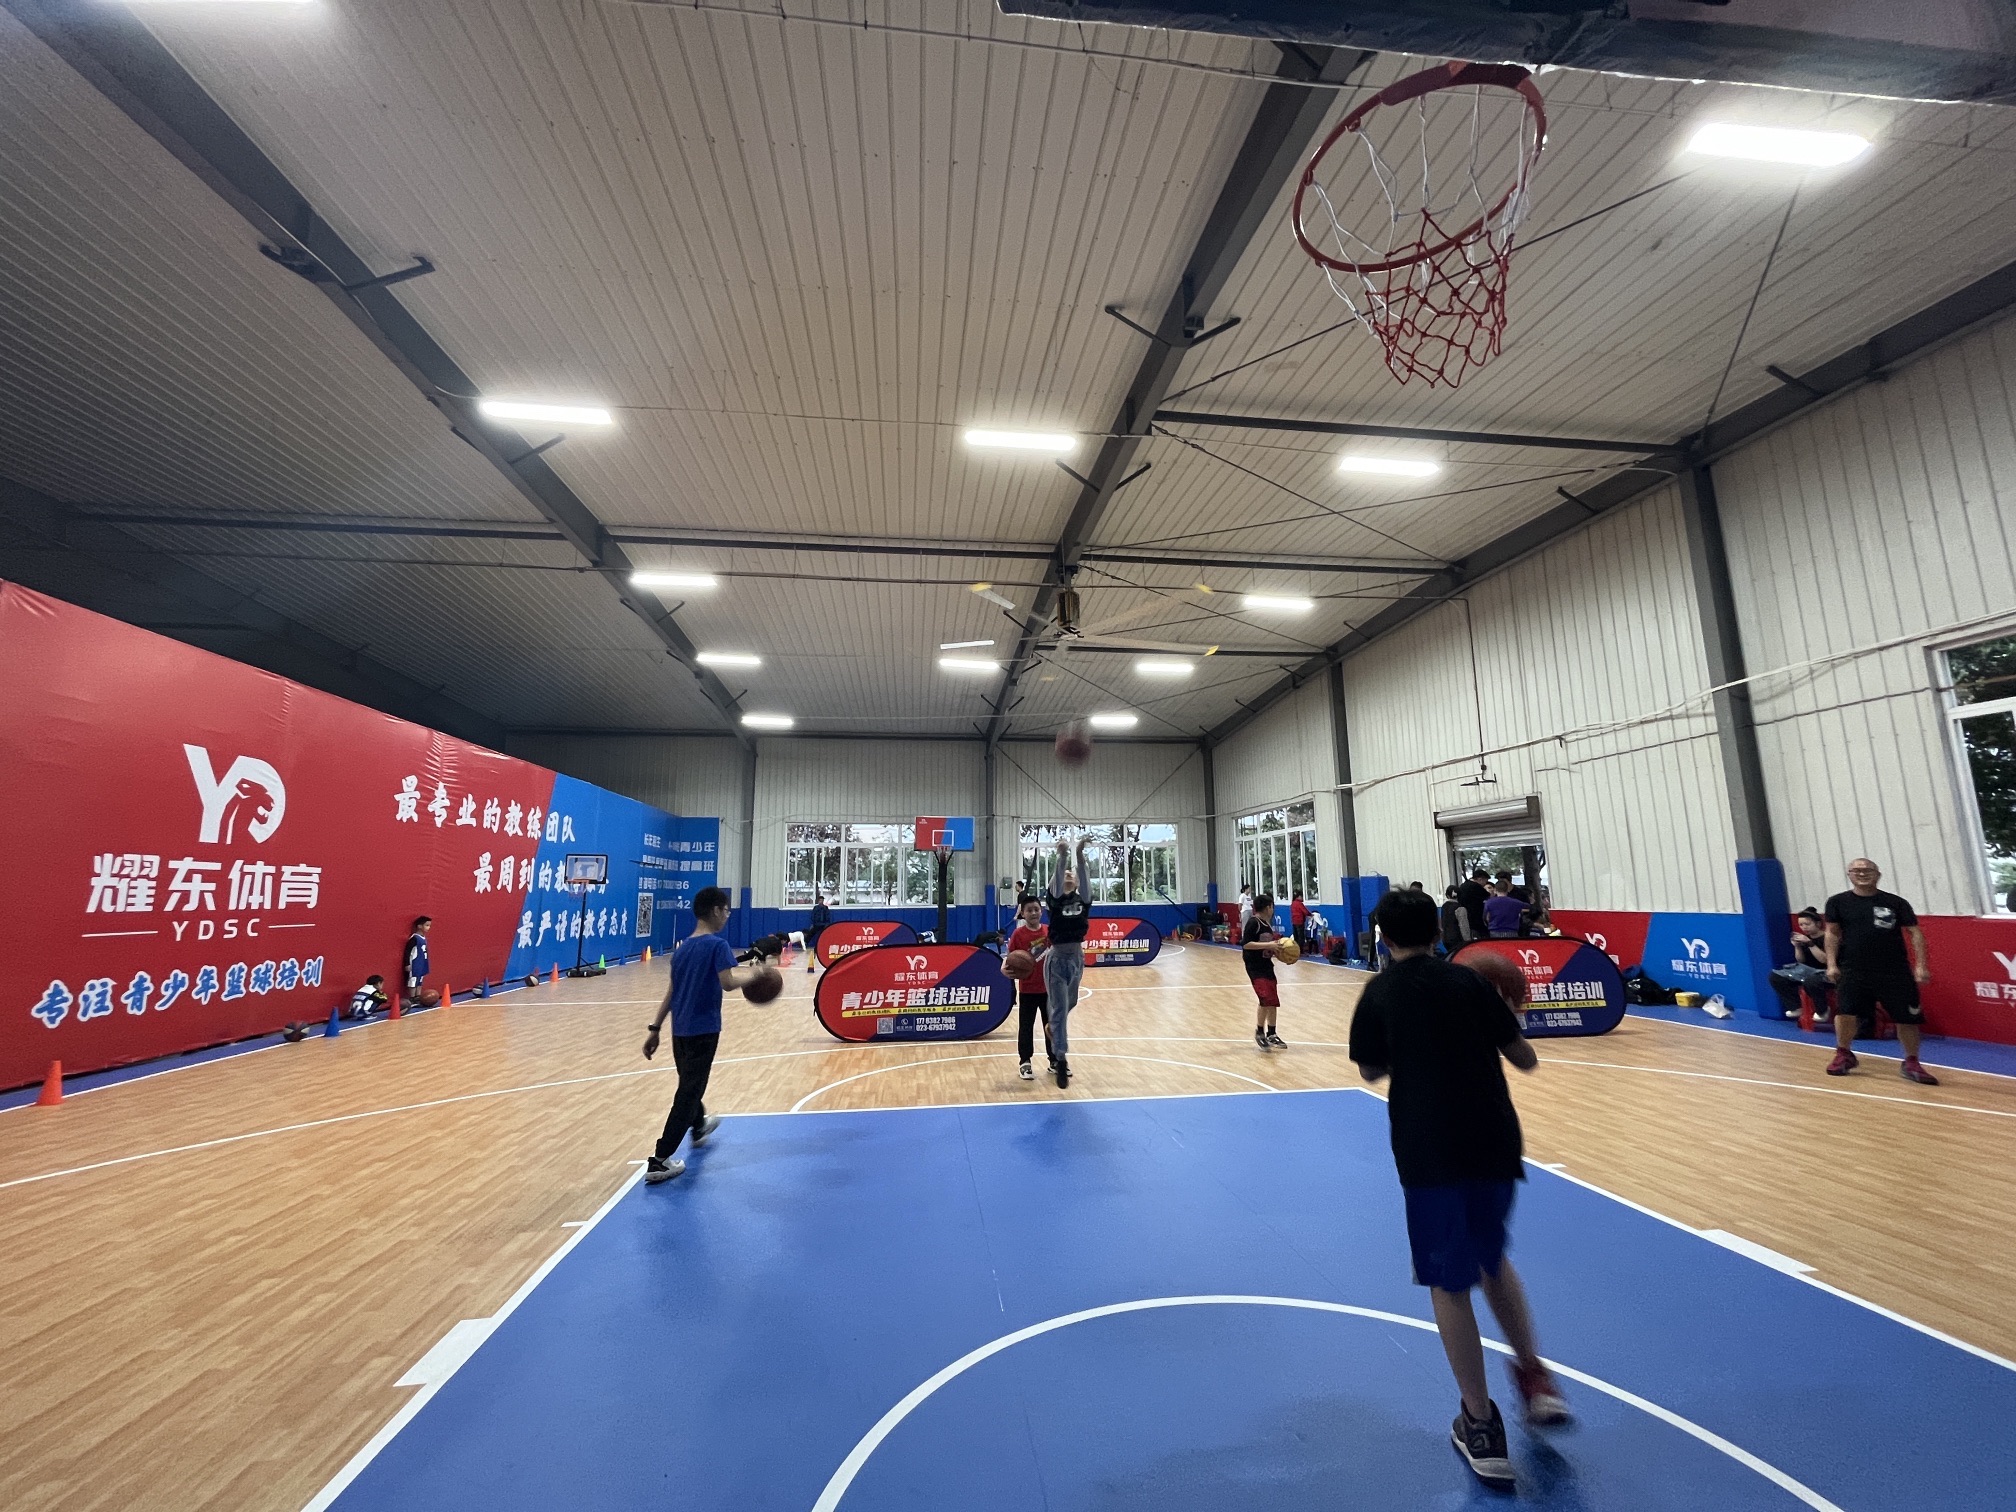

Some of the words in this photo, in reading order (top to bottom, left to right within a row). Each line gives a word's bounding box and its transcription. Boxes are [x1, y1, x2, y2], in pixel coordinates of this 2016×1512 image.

[394, 775, 576, 843] 最专业的教练团队
[86, 853, 322, 913] 耀东体育
[473, 852, 609, 894] 最周到的教
[172, 918, 261, 942] YDSC
[1519, 965, 1554, 975] 东体育
[1671, 959, 1727, 976] 耀东体育
[31, 956, 324, 1029] 专注青少年篮球培训
[841, 986, 990, 1010] 青少年篮球培训
[1526, 981, 1605, 1002] 篮球培训
